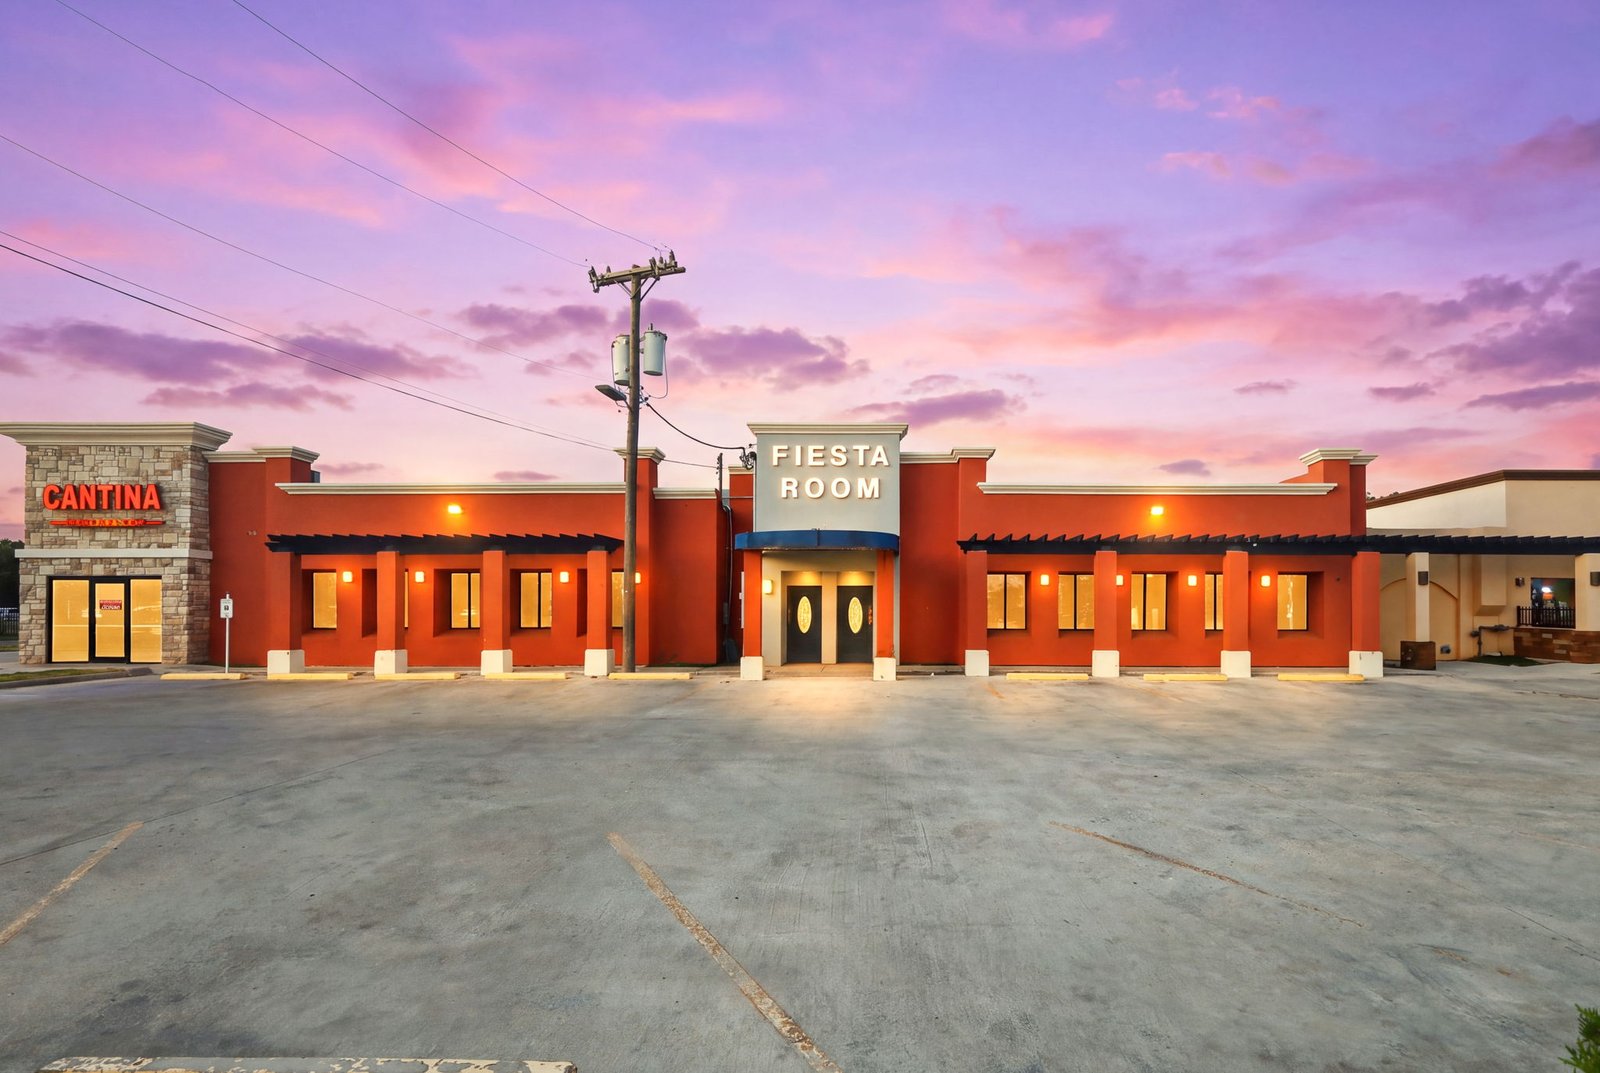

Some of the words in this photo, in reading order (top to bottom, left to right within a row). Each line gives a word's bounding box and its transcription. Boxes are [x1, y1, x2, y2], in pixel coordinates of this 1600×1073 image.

[772, 445, 890, 467] FIESTA
[43, 484, 161, 510] CANTINA
[781, 477, 880, 499] ROOM
